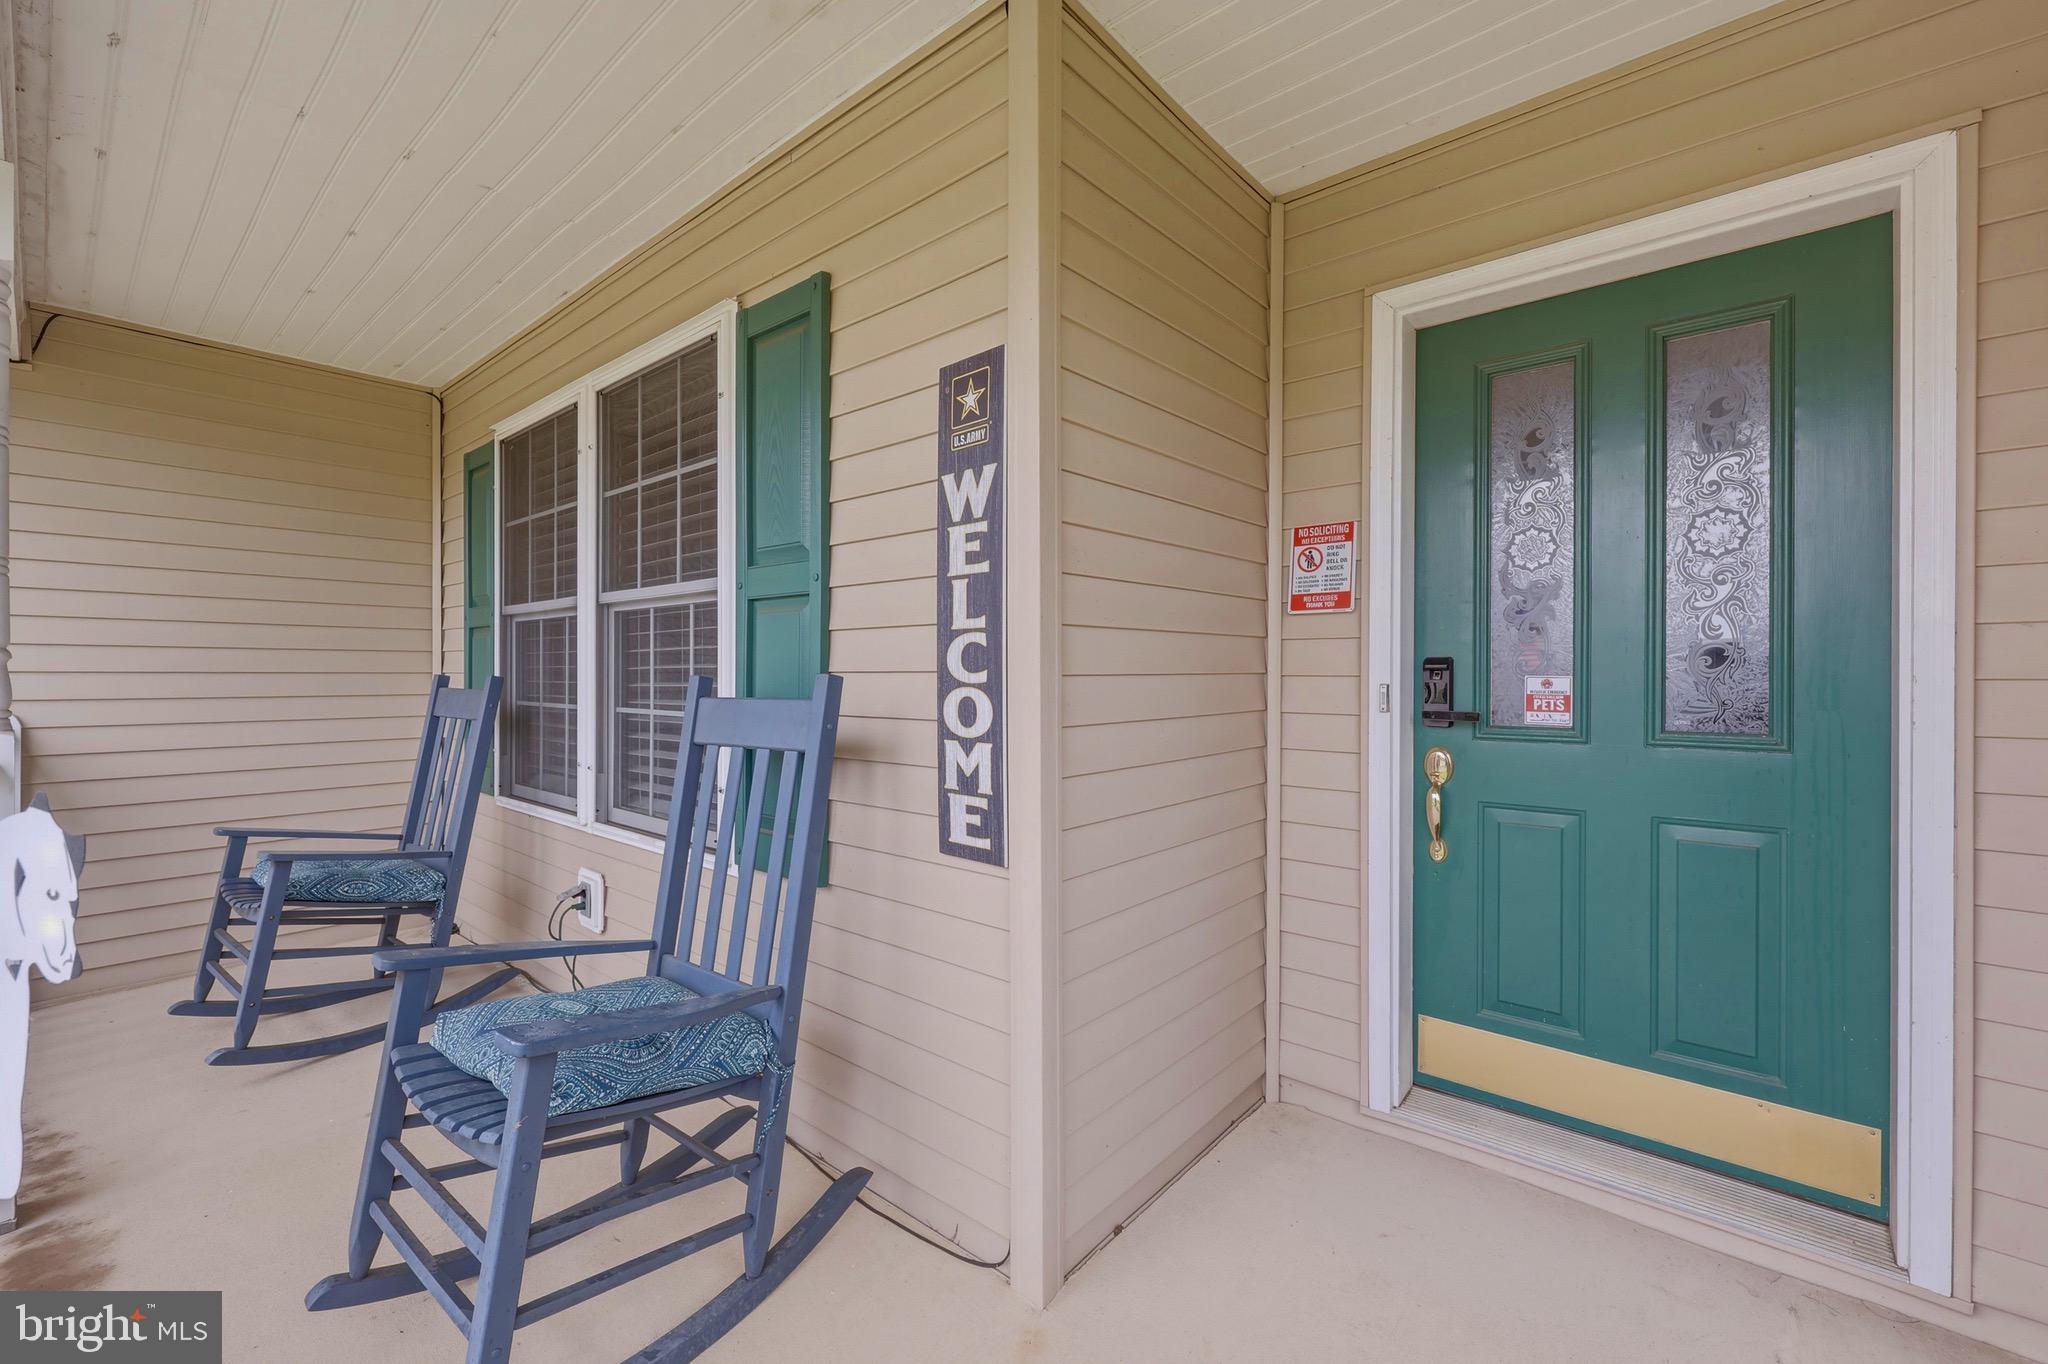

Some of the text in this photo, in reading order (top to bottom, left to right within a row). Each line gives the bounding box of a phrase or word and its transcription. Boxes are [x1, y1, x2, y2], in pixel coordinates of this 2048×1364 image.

[1298, 523, 1350, 538] NO SOLICITING
[1311, 534, 1346, 544] EXCEPTIONS
[1312, 594, 1339, 602] EXCUSES
[1305, 601, 1324, 609] THANK
[940, 462, 998, 850] WELCOME
[1533, 699, 1565, 711] PETS
